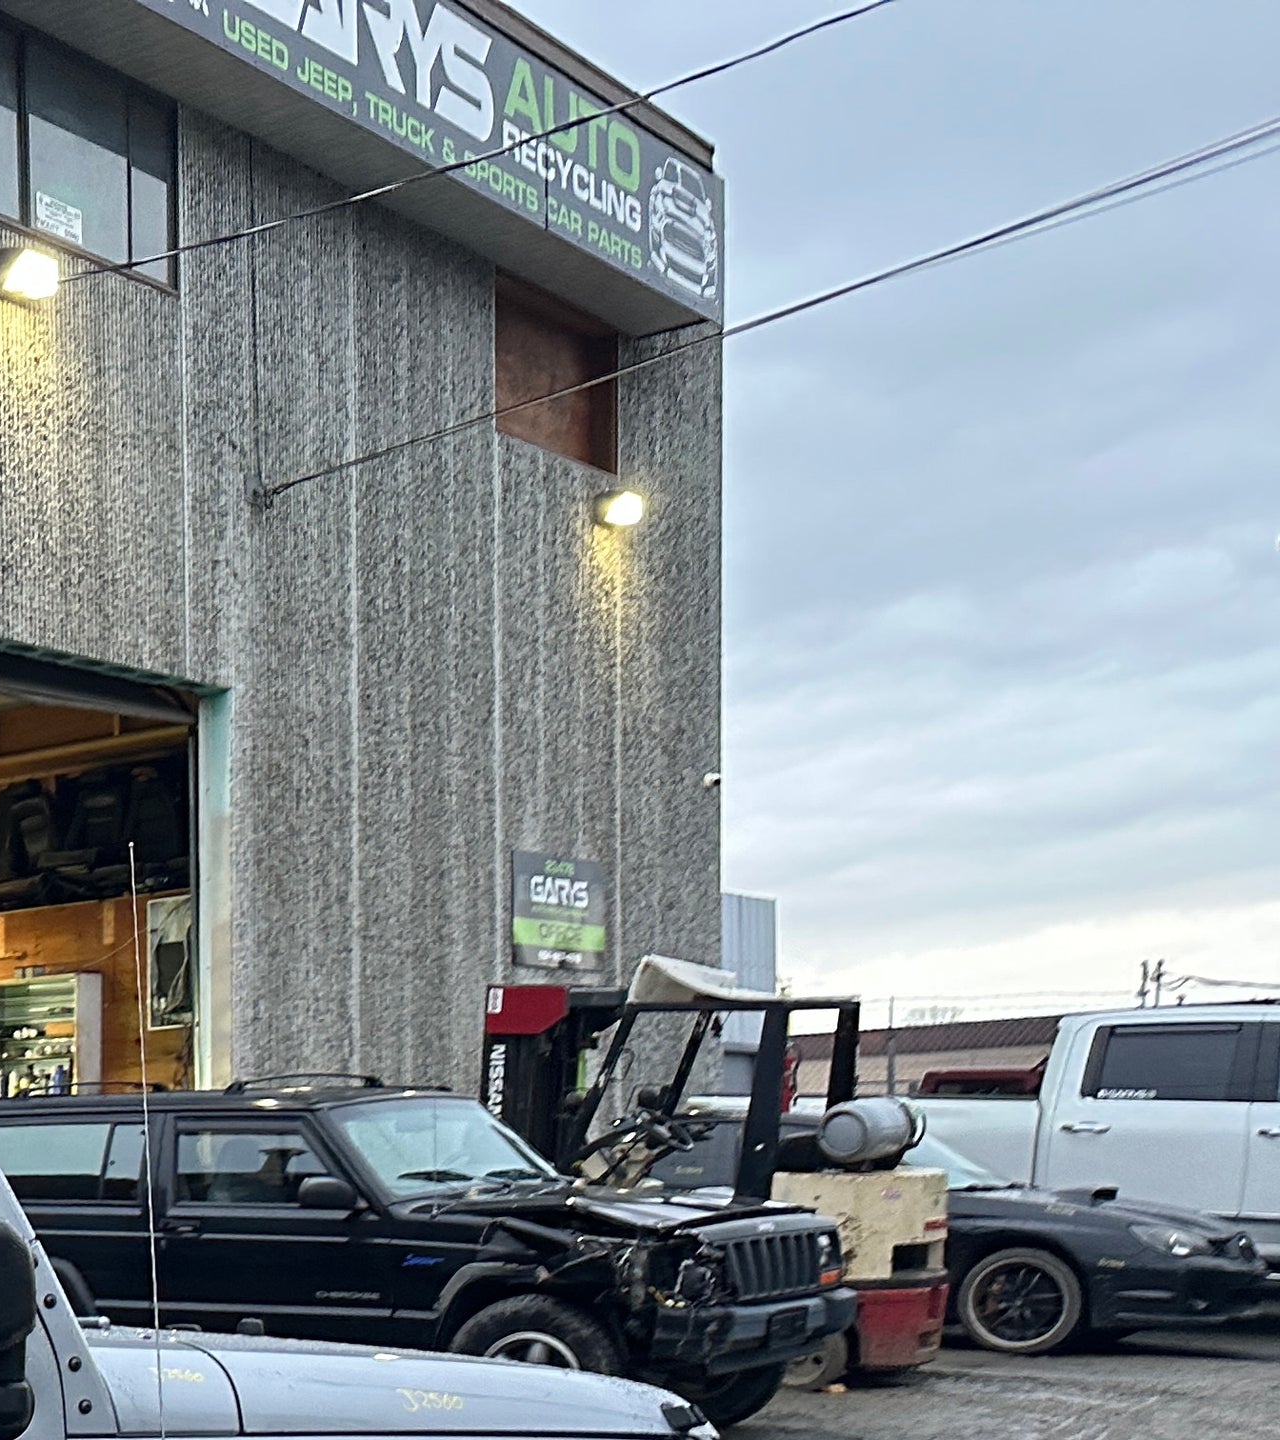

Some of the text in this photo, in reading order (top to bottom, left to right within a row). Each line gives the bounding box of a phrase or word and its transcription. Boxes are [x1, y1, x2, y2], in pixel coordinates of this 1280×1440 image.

[222, 8, 642, 270] USED JEEP, TRUCK & SPORTS CAR PARTS
[502, 119, 642, 232] RECYCLING
[504, 56, 640, 193] AUTO
[395, 1387, 464, 1413] J2560
